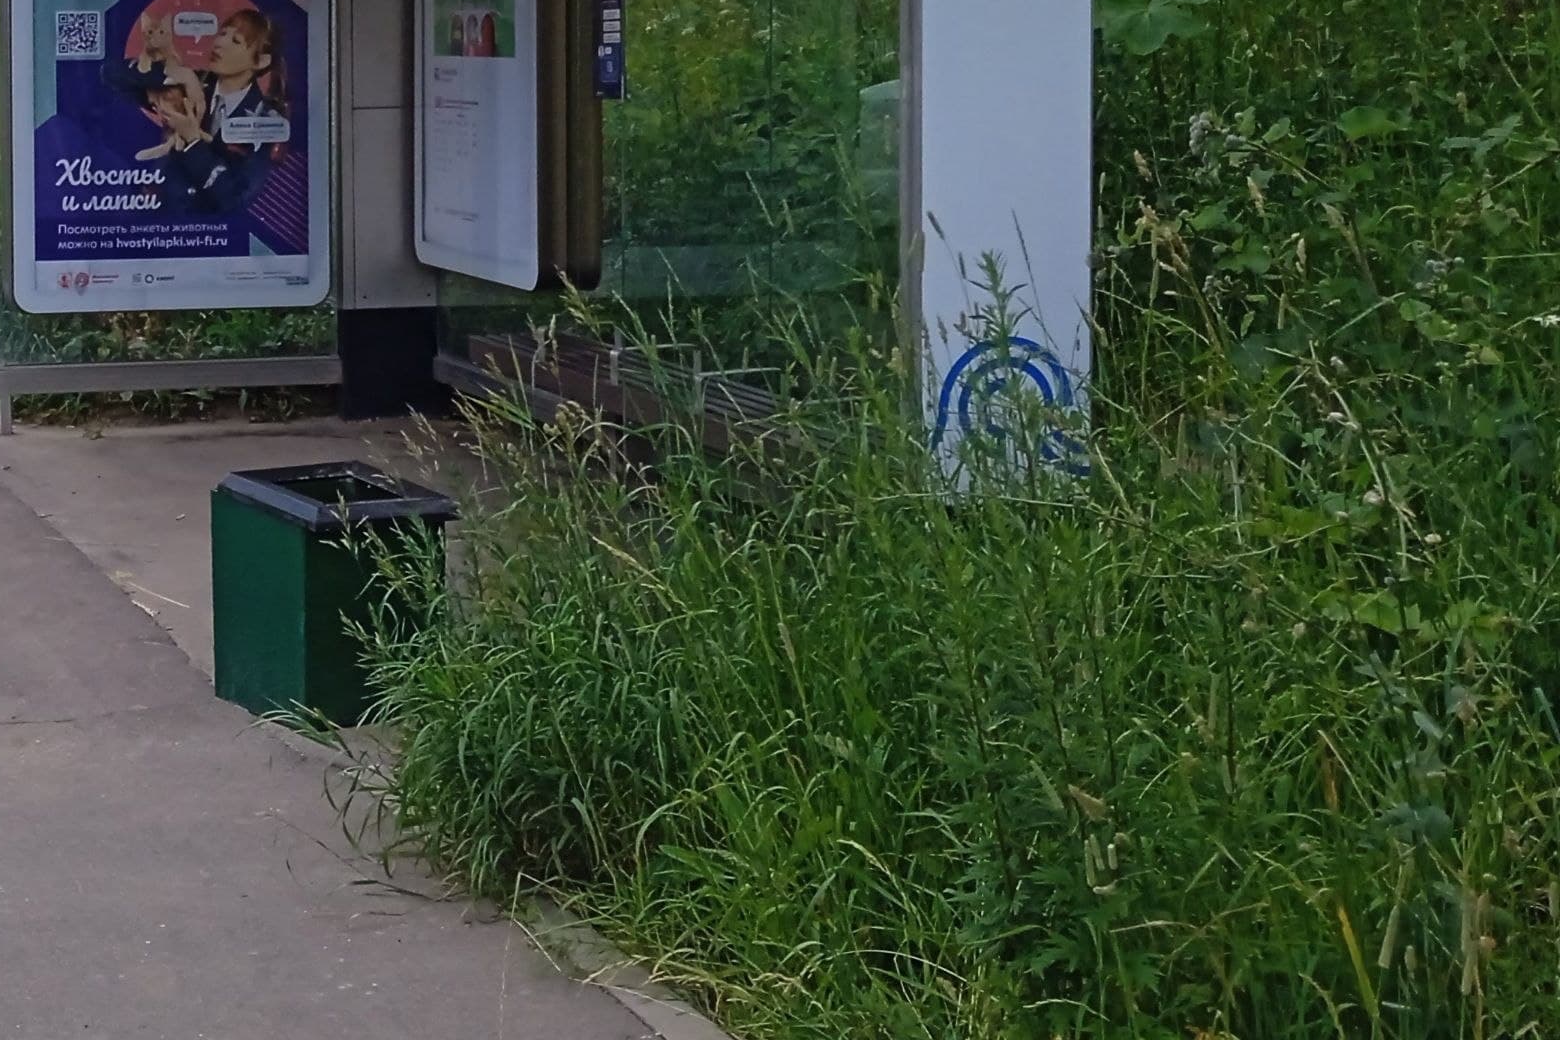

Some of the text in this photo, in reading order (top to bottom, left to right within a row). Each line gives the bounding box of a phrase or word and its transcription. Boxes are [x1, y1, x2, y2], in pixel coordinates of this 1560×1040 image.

[55, 155, 166, 187] Хвосты
[62, 192, 162, 212] и лапки
[57, 223, 229, 236] Посмотреть анкеты животных
[57, 236, 229, 251] можно на hvostyilapki.wi-fi.ru
